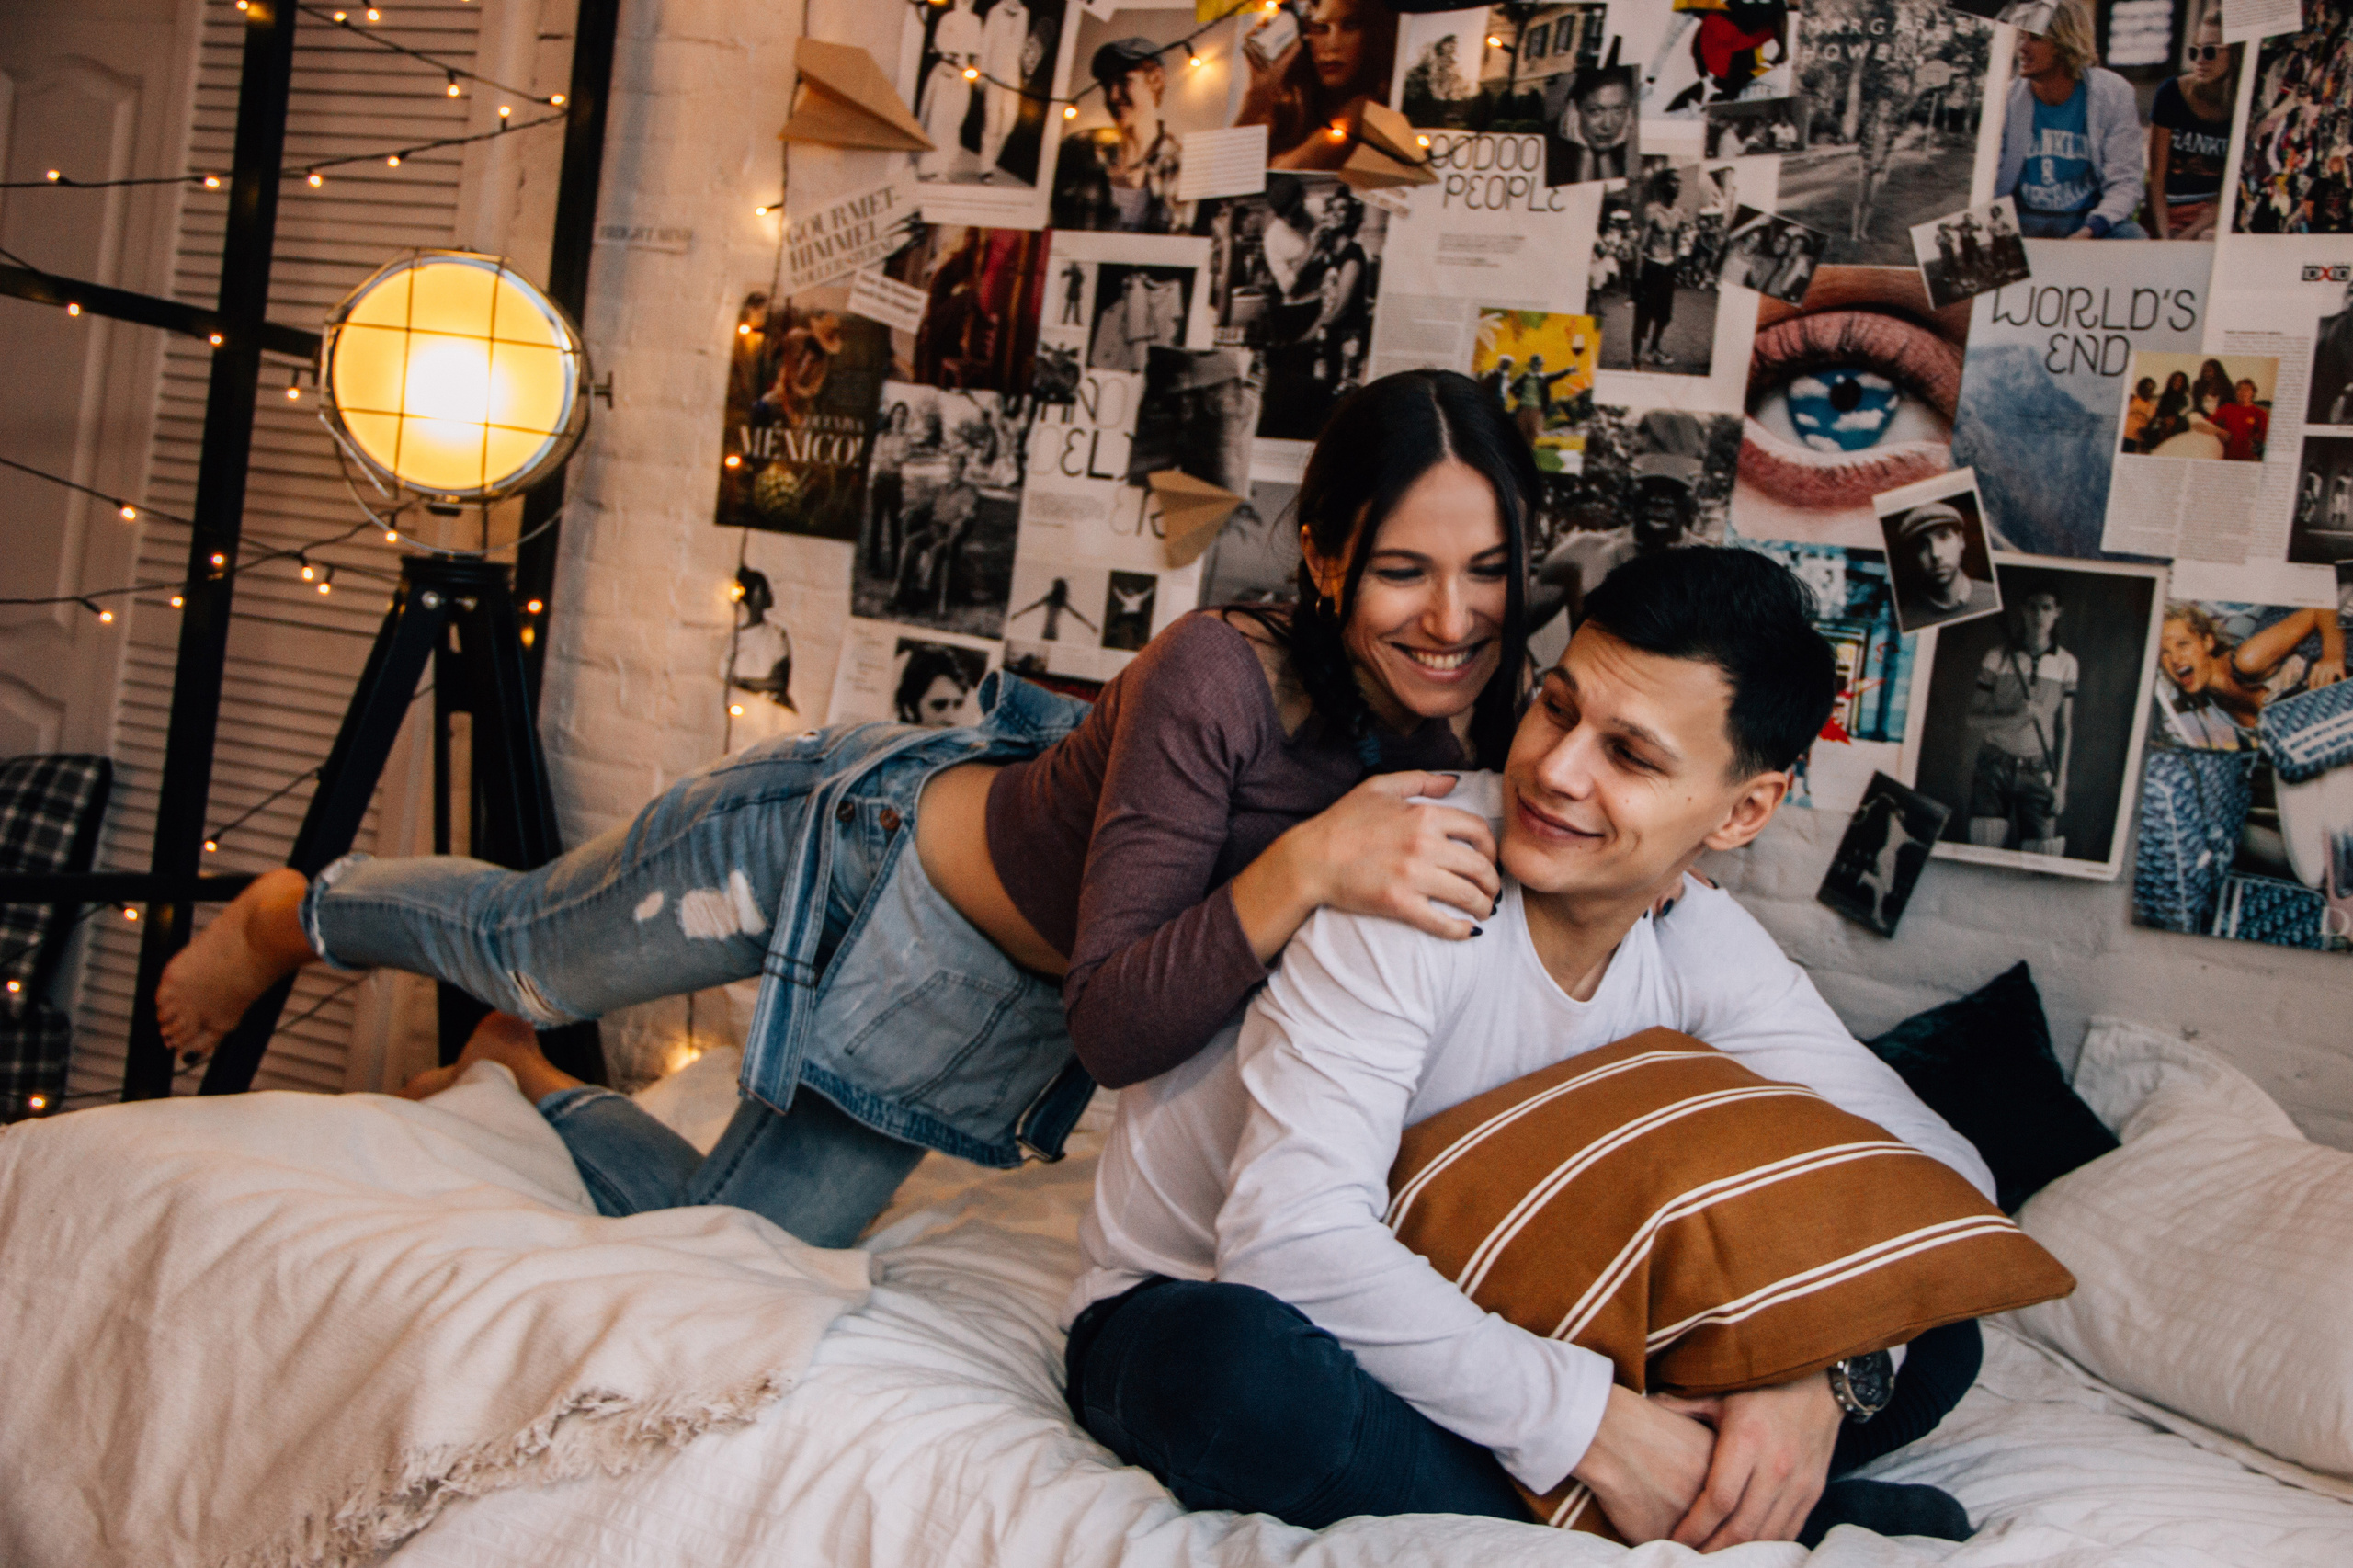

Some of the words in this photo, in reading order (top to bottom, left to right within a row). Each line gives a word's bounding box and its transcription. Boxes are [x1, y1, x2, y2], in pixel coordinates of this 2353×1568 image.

[1430, 134, 1541, 172] OODOO
[1443, 174, 1566, 212] PEOPLE
[1992, 285, 2197, 332] WORLD'S
[2045, 332, 2131, 378] END
